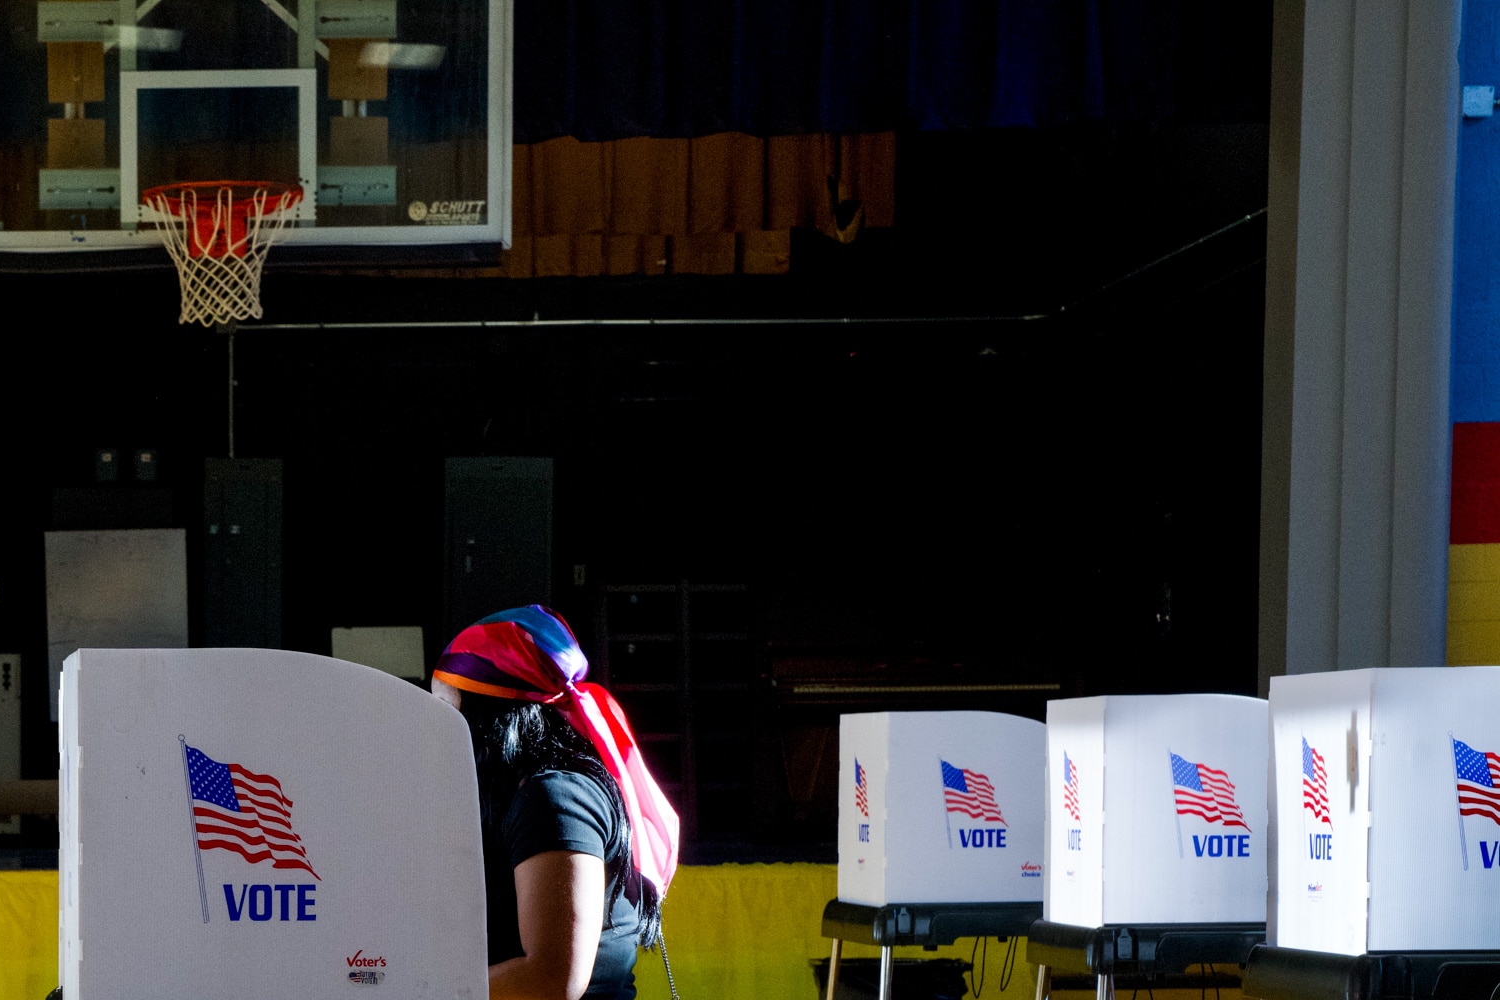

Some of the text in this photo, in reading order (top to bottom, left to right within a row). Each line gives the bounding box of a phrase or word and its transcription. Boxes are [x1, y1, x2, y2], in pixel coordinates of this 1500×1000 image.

[429, 201, 486, 213] SCHUTT
[959, 829, 1007, 848] VOTE
[1192, 835, 1250, 857] VOTE
[1309, 833, 1332, 860] VOTE
[223, 884, 317, 921] VOTE
[346, 949, 387, 967] Voter's
